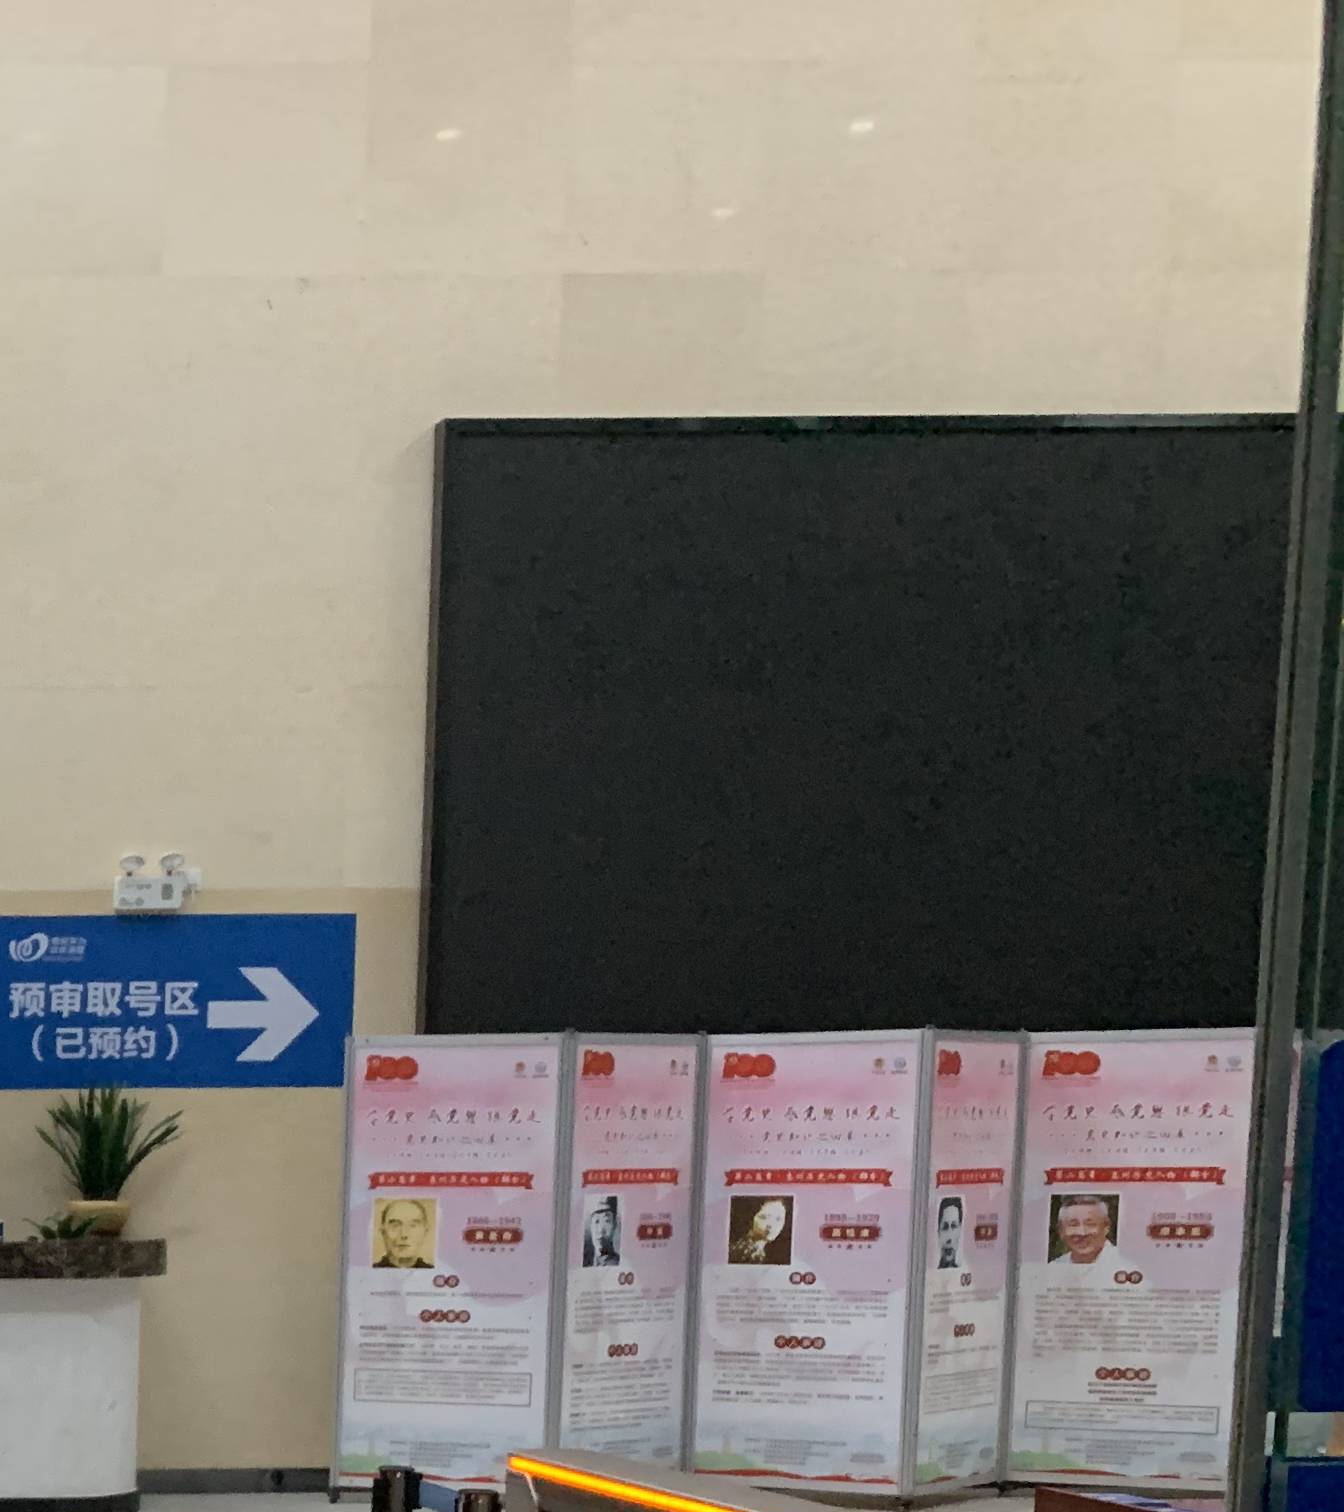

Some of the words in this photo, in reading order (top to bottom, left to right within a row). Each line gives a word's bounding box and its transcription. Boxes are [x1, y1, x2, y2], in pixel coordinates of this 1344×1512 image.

[9, 981, 199, 1019] 预审取号区
